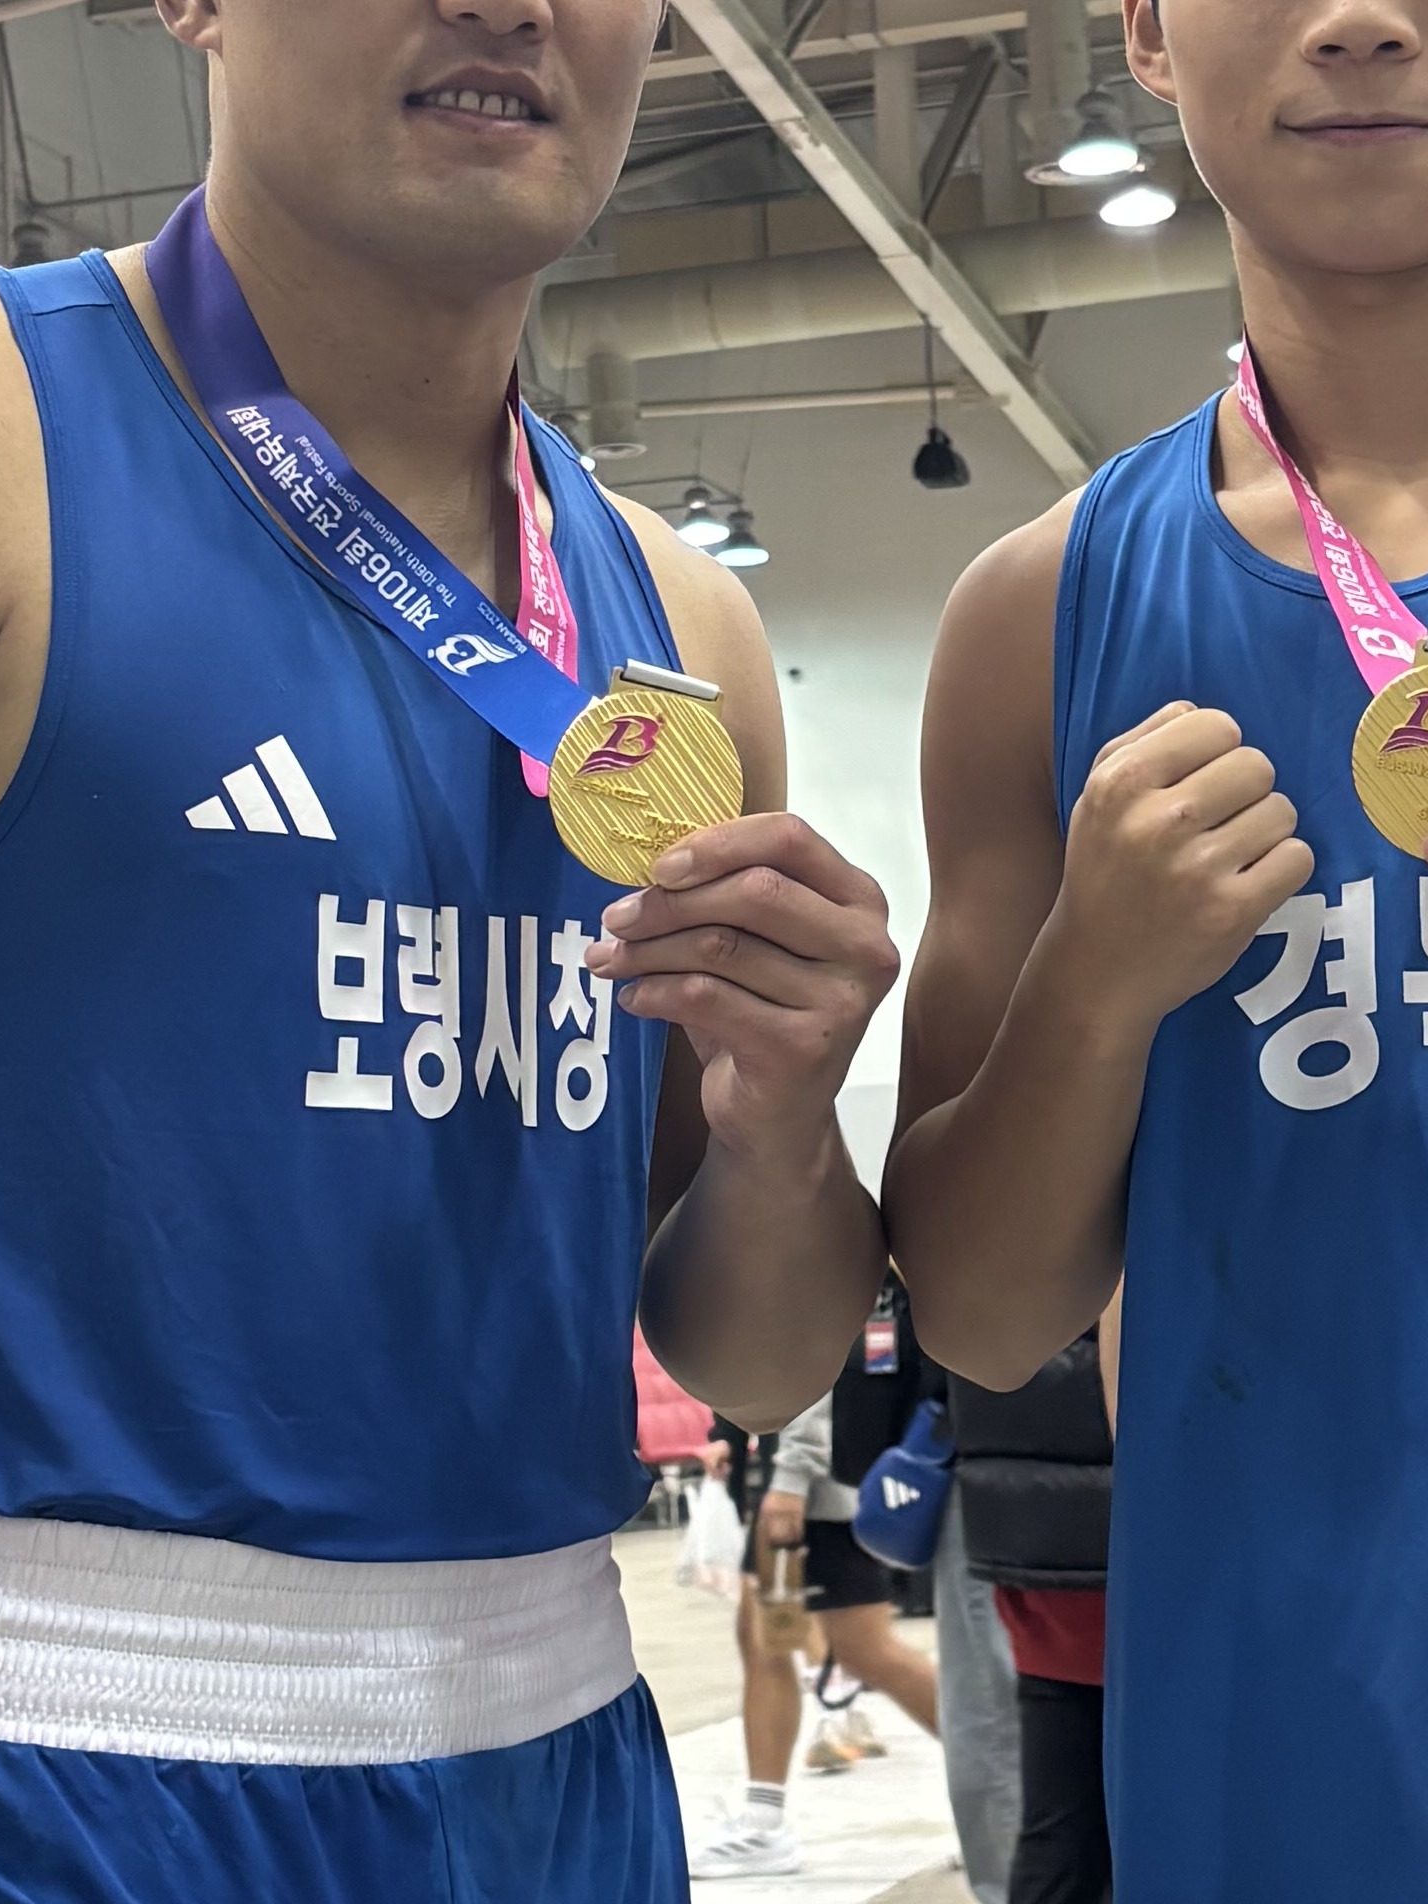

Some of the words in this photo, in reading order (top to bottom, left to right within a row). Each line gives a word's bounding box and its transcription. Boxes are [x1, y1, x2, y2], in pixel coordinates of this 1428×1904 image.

[227, 406, 341, 535] 전국체육대회
[294, 434, 327, 475] Festival
[323, 470, 361, 512] Sports
[358, 508, 408, 557] National
[337, 528, 438, 630] 제106회
[435, 583, 457, 608] The
[305, 893, 614, 1132] 보령시청
